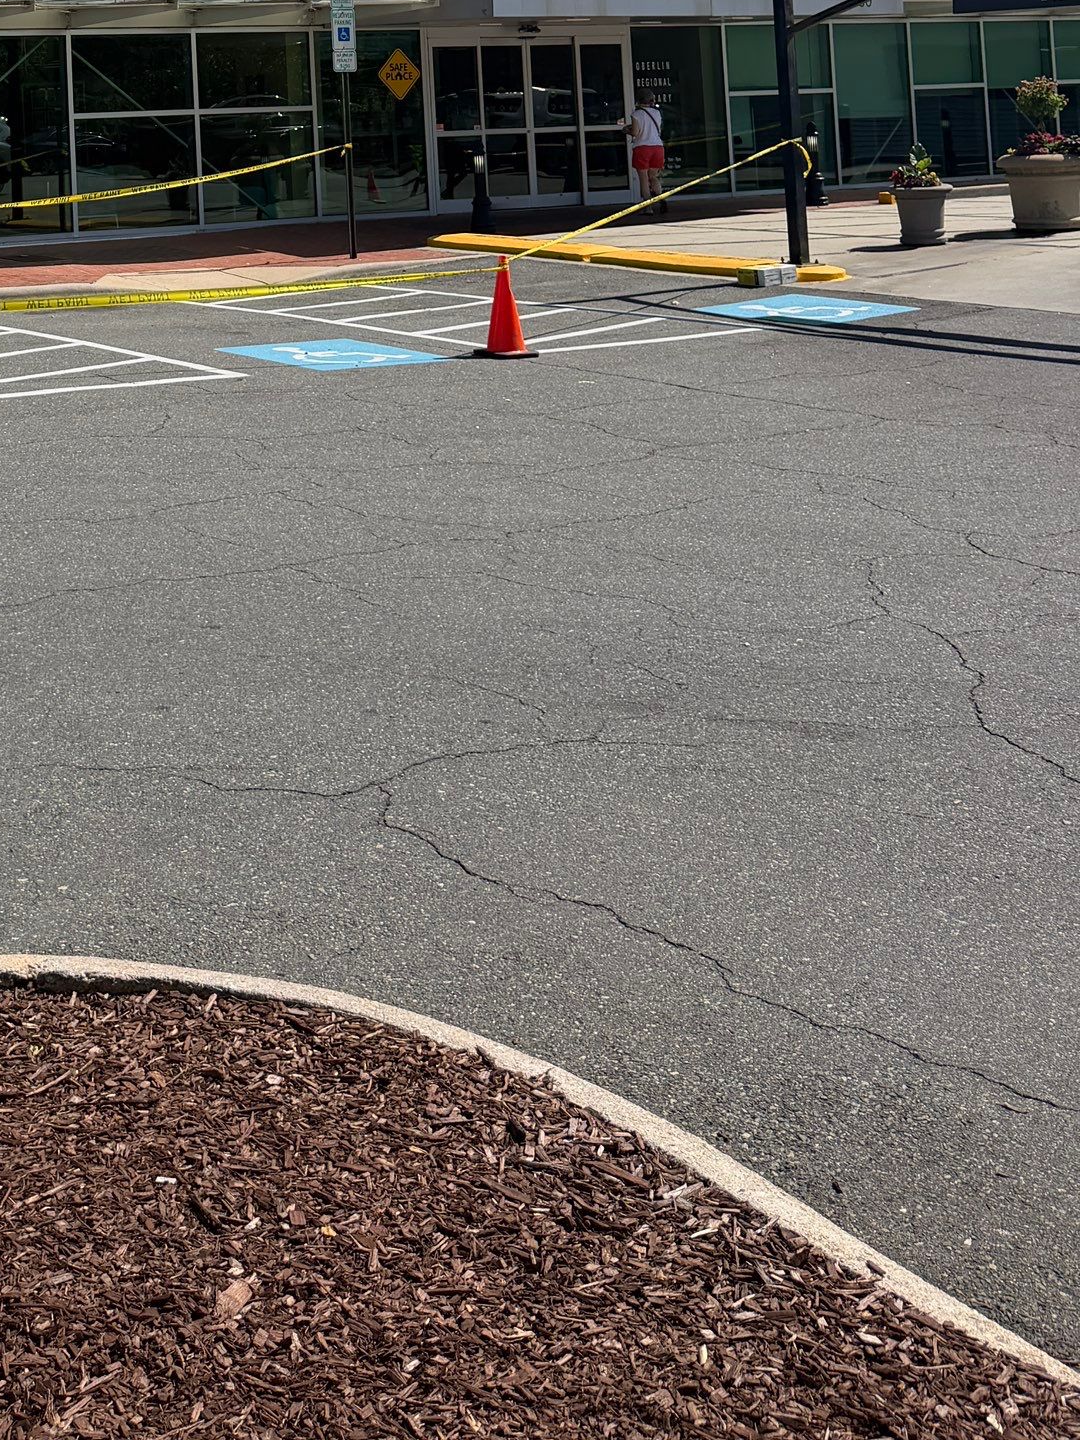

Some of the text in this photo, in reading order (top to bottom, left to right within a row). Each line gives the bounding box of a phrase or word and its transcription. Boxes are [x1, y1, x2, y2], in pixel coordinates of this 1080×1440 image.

[389, 63, 409, 72] SAFE
[635, 61, 671, 70] OBERLIN
[385, 72, 413, 81] PLACE
[636, 78, 672, 87] REGIONAL
[49, 197, 71, 205] PAINT
[81, 193, 97, 201] WET
[98, 190, 121, 200] PAINT
